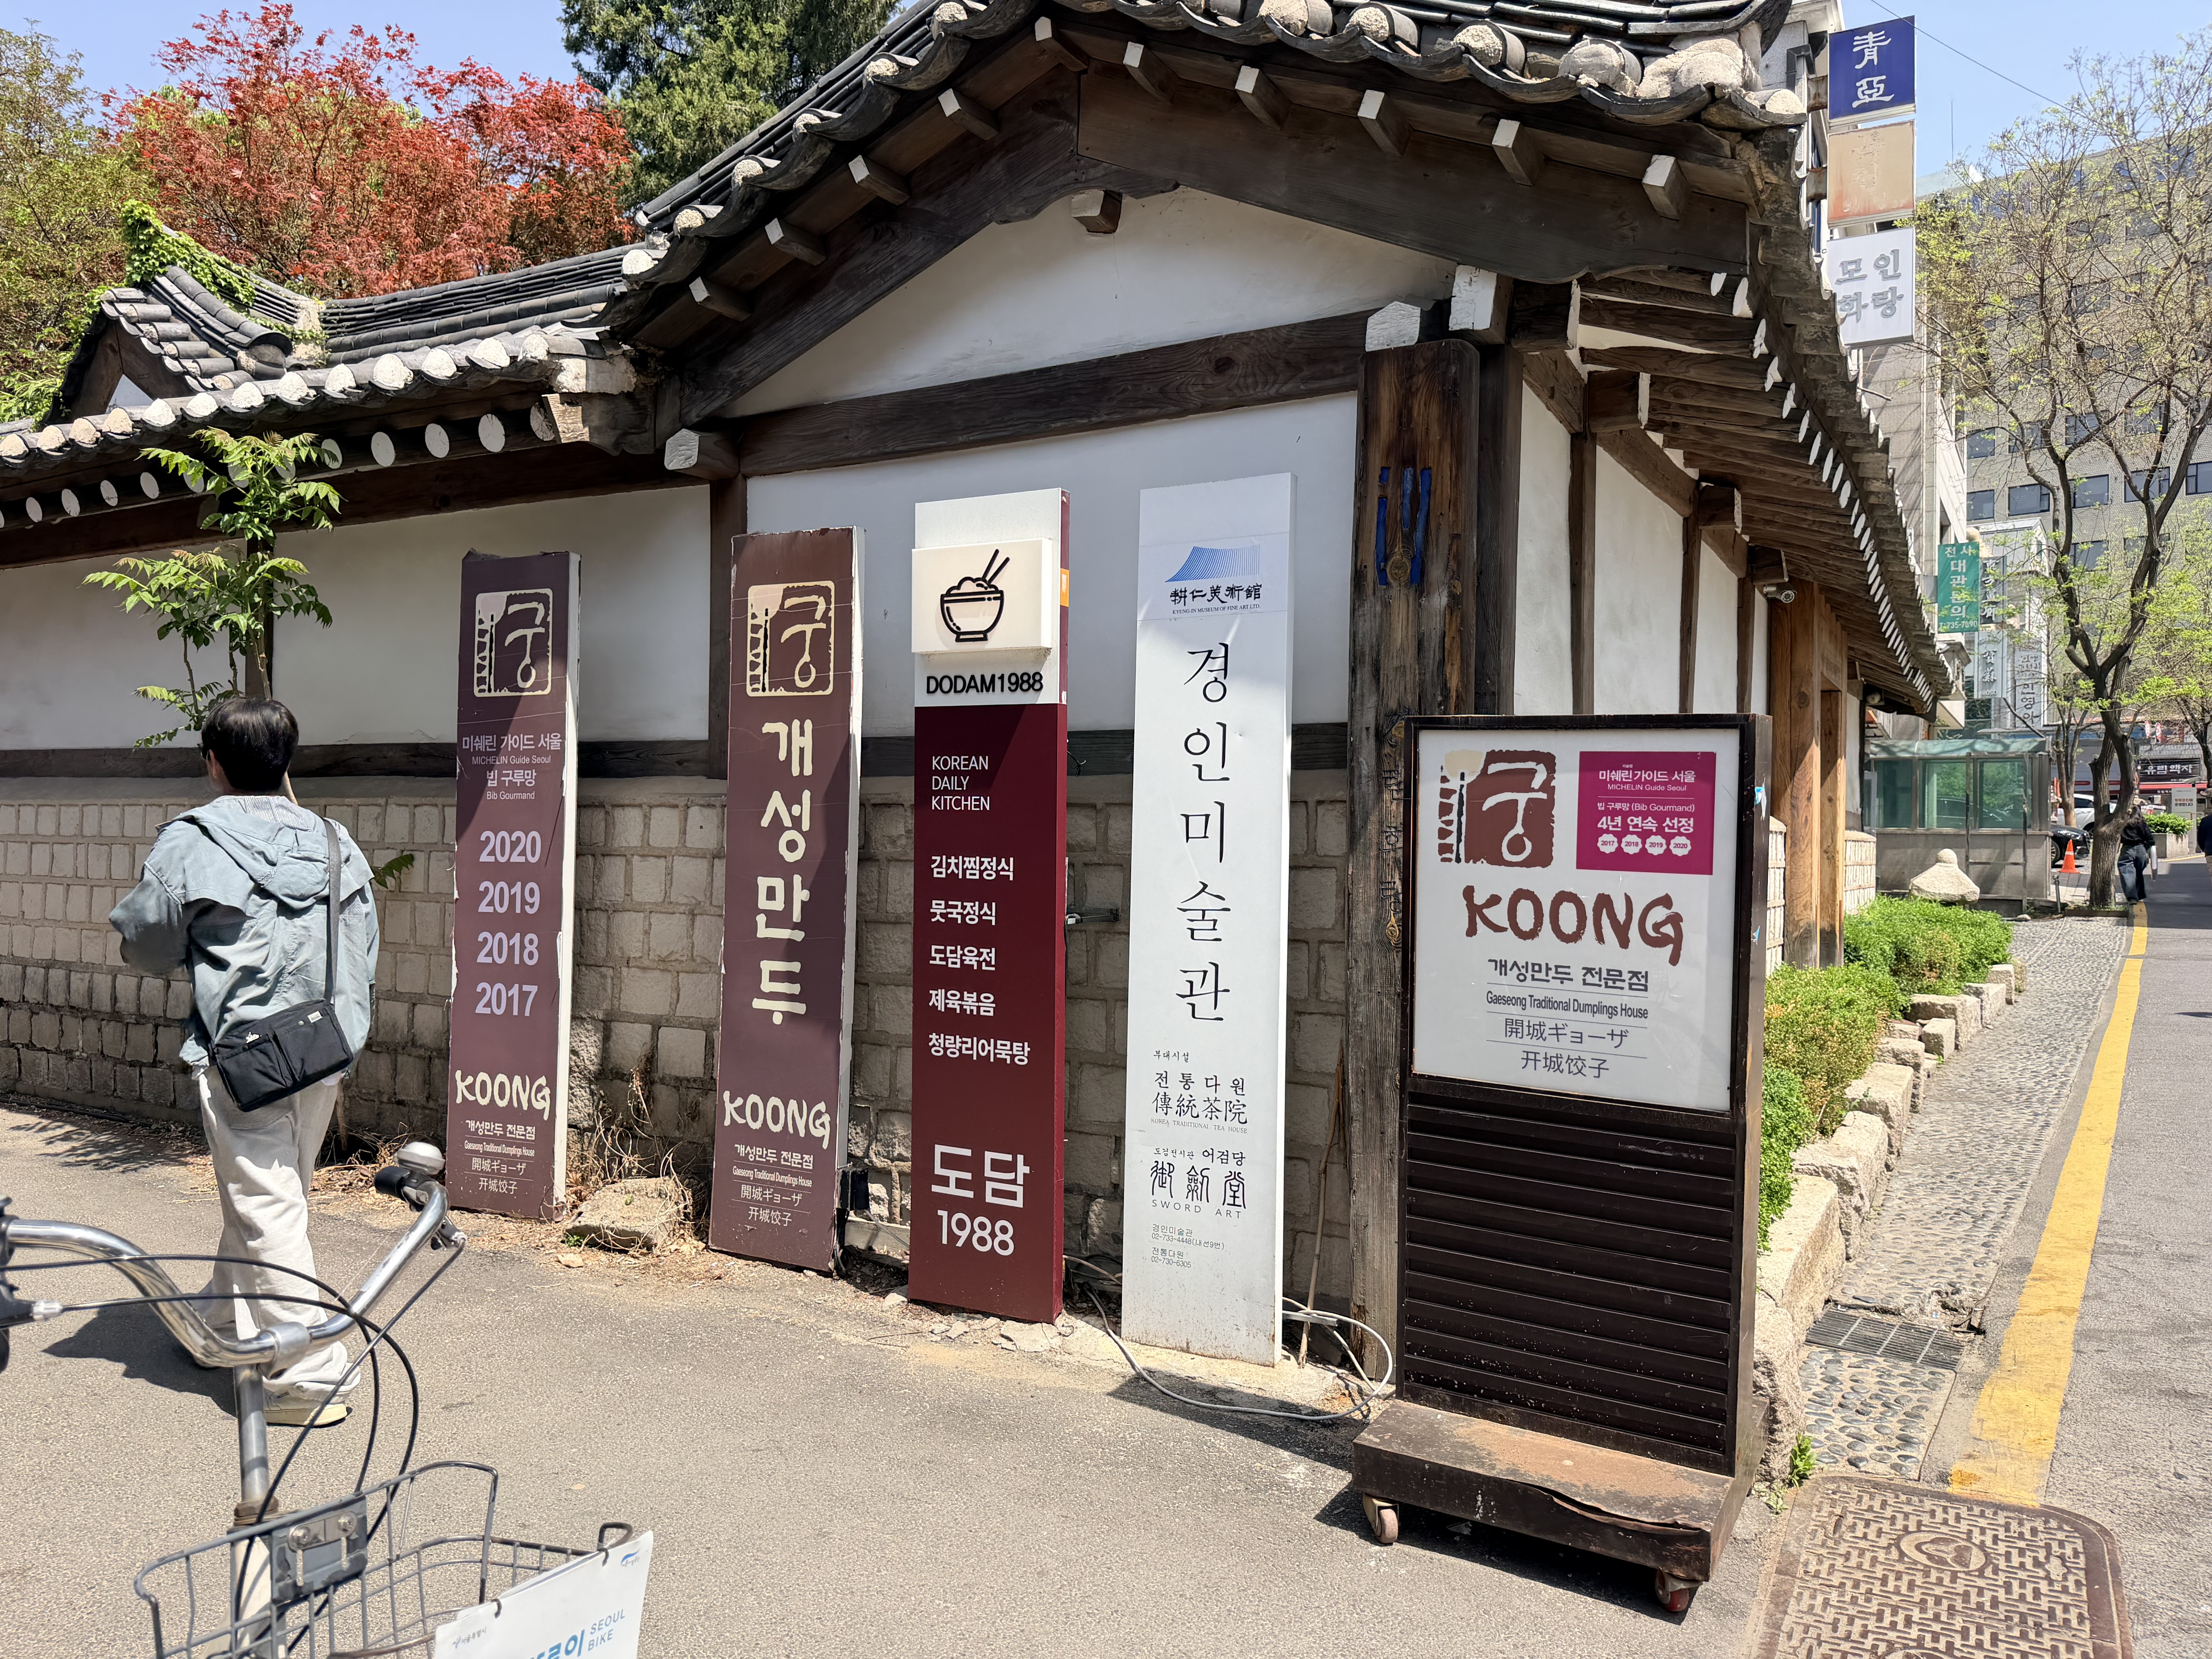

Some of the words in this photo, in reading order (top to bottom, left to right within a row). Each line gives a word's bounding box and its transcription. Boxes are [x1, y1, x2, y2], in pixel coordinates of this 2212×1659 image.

[1835, 249, 1902, 285] 모인
[1838, 286, 1904, 323] 화랑
[926, 672, 1043, 695] DODAM1988
[462, 735, 496, 752] 미쉐린
[500, 734, 534, 751] 가이드
[538, 733, 562, 750] 서울
[472, 756, 508, 764] MICHELIN
[510, 755, 531, 764] Guide
[532, 754, 551, 764] Seoul
[932, 756, 989, 771] KOREAN
[486, 770, 498, 787] 빕
[501, 769, 537, 787] 구루망
[932, 776, 969, 791] DAILY
[1599, 769, 1632, 782] 미쉐린
[1634, 770, 1669, 782] 가이드
[1671, 770, 1696, 783] 서울
[486, 791, 498, 800] Bib
[499, 791, 535, 800] Gourmand
[931, 795, 990, 811] KITCHEN
[1597, 802, 1604, 811] 빕
[1607, 802, 1630, 811] 구루망
[1632, 803, 1647, 811] (Bib
[1649, 803, 1695, 813] Gourmand)
[1176, 643, 1231, 1021] 경인미술관
[1597, 816, 1621, 831] 4년
[1627, 816, 1658, 832] 연속
[1662, 817, 1694, 833] 선정
[479, 830, 541, 863] 2020
[752, 719, 812, 1025] 개성만두
[931, 855, 1015, 881] 김치찜정식
[478, 881, 540, 914] 2019
[930, 900, 996, 926] 뭇국정식
[1462, 884, 1684, 967] KOONG
[476, 931, 539, 966] 2018
[929, 945, 996, 971] 도담육전
[1487, 958, 1573, 985] 개성만두
[1581, 965, 1649, 992] 전문점
[475, 982, 538, 1017] 2017
[929, 989, 996, 1016] 제육볶음
[1486, 990, 1527, 1010] Gaeseong
[1528, 994, 1571, 1013] Traditional
[1572, 998, 1618, 1019] Dumplings
[1620, 1002, 1648, 1020] House
[1505, 1018, 1629, 1049] 開城ギョーザ
[929, 1032, 1030, 1065] 청량리어묵탕
[1153, 1050, 1189, 1063] 부대시설
[1521, 1050, 1610, 1079] 开城饺子
[1154, 1070, 1245, 1096] 전통다원
[455, 1070, 551, 1121] KOONG
[723, 1091, 830, 1149] KOONG
[1151, 1092, 1247, 1124] 傳統茶院
[465, 1120, 503, 1136] 개성만두
[507, 1124, 536, 1140] 전문점
[1173, 1120, 1209, 1129] TRADITIONAL
[464, 1140, 483, 1153] Gaeseong
[483, 1142, 502, 1154] Traditional
[502, 1144, 522, 1158] Dumplings
[522, 1147, 535, 1157] House
[735, 1144, 777, 1163] 개성만두
[781, 1151, 813, 1170] 전문점
[1154, 1148, 1194, 1159] 도검전시관
[1202, 1148, 1245, 1166] 어검당
[472, 1157, 527, 1175] 開城ギョーザ
[733, 1166, 753, 1180] Gaeseong
[754, 1168, 775, 1181] Traditional
[776, 1172, 798, 1186] Dumplings
[799, 1176, 812, 1187] House
[931, 1144, 1030, 1208] 도담
[479, 1177, 517, 1195] 开城饺子
[741, 1185, 802, 1207] 開城ギョーザ
[748, 1206, 792, 1227] 开城饺子
[1152, 1199, 1201, 1213] SWORD
[1215, 1209, 1241, 1219] ART
[937, 1209, 1015, 1256] 1988
[1152, 1224, 1193, 1237] 경인미술관
[1151, 1256, 1191, 1268] 02-730-6305
[1152, 1247, 1183, 1259] 전통다원
[590, 1609, 625, 1635] SEOUL
[588, 1629, 613, 1651] BIKE
